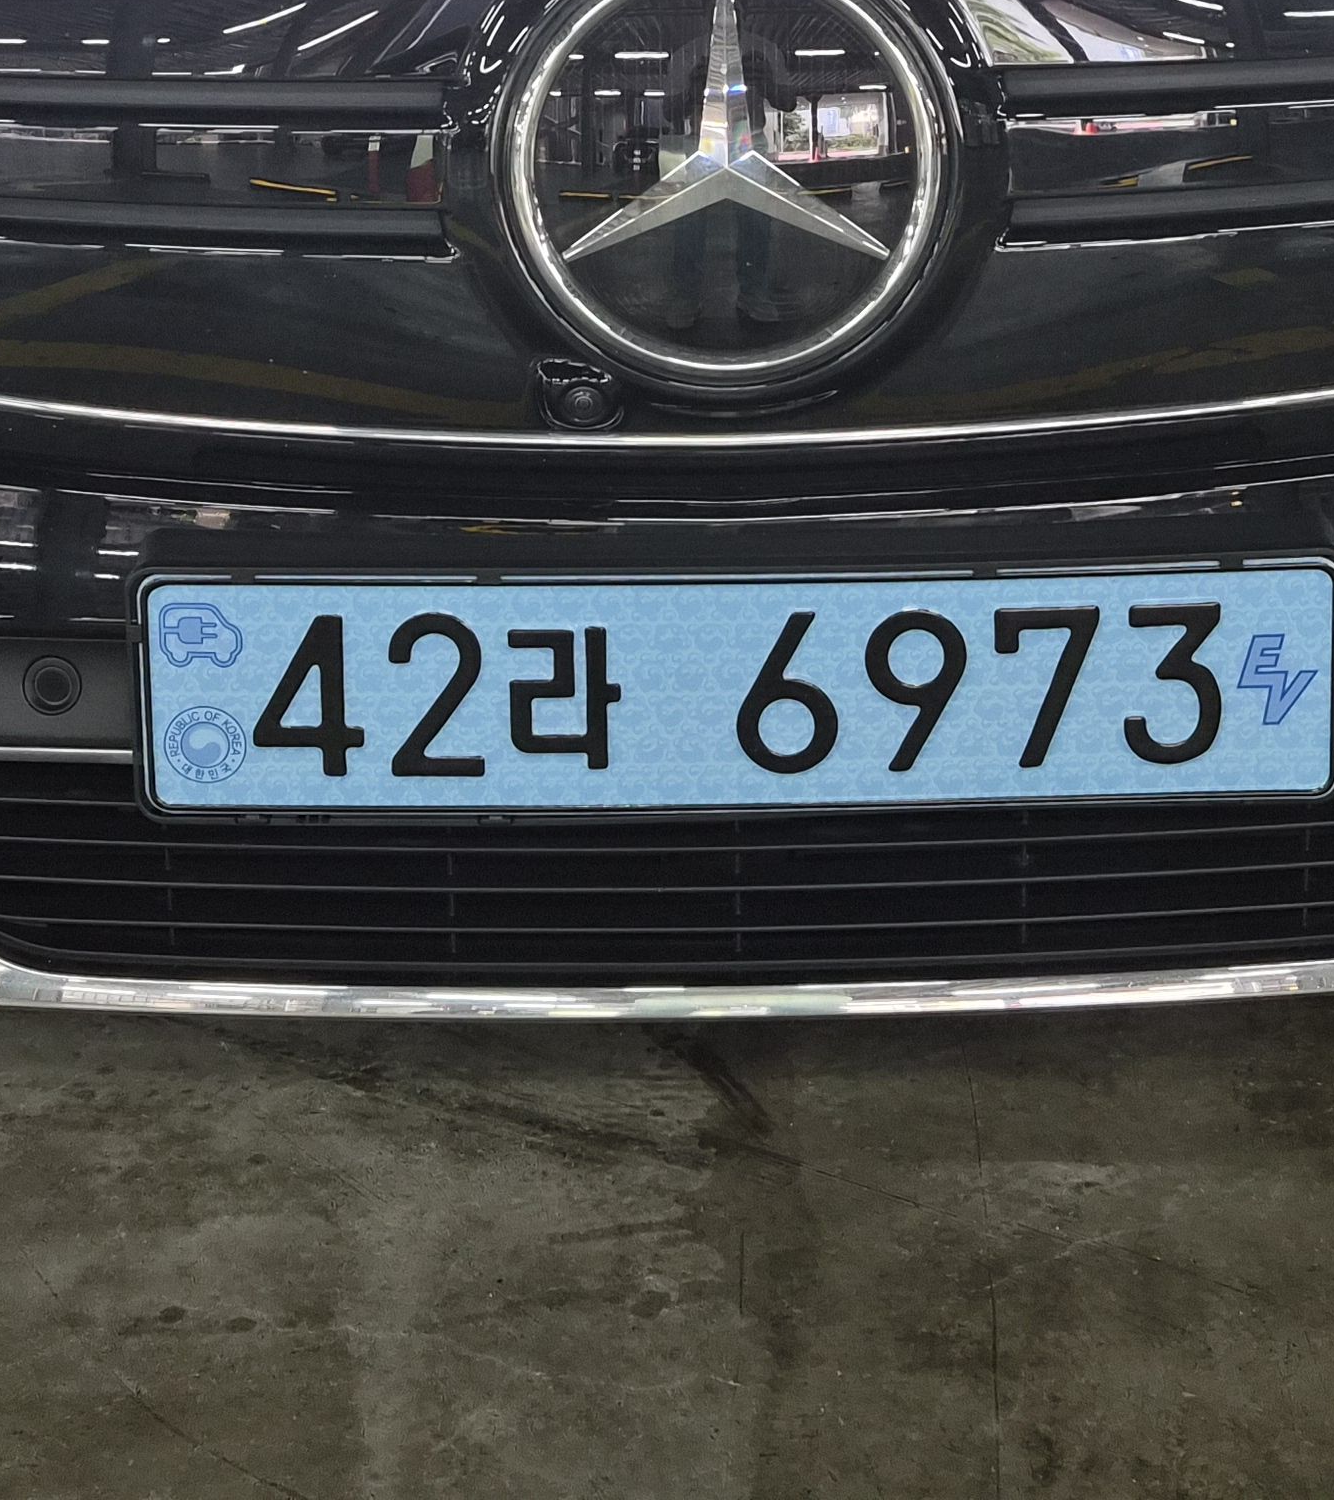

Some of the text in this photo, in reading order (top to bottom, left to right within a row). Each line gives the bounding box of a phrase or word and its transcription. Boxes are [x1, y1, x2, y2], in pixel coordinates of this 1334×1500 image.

[252, 602, 1223, 778] 42라 6973
[1237, 633, 1319, 725] EV
[168, 710, 242, 757] REPUBLIC OF KOREA
